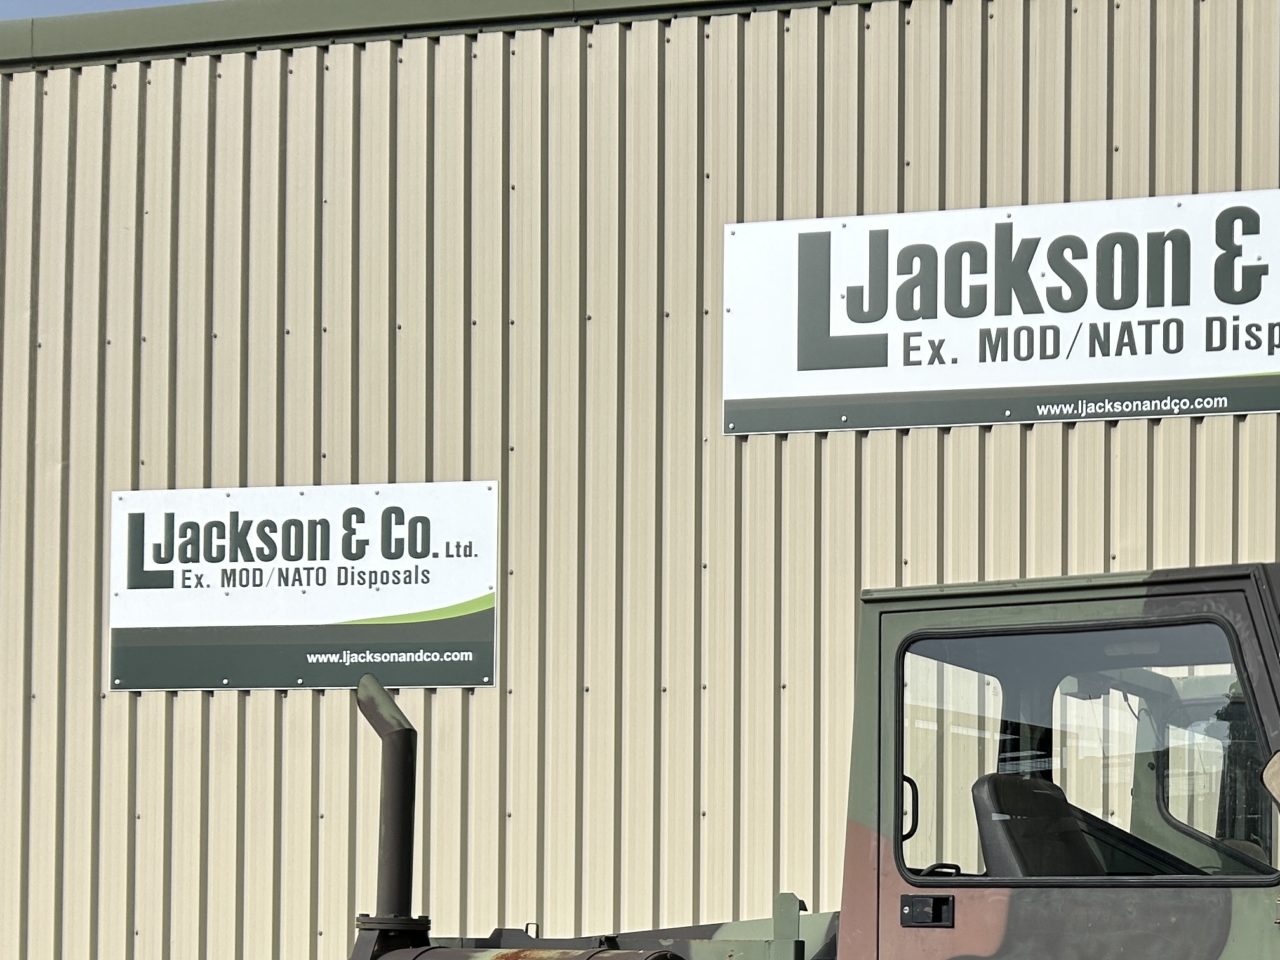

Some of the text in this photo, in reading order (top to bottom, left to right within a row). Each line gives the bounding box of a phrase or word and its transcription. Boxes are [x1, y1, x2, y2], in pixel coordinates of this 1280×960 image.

[1214, 206, 1268, 305] &
[903, 332, 957, 366] Ex.
[979, 318, 1183, 362] MOD/NATO
[1037, 397, 1227, 417] www.ljacksonandco.com
[342, 507, 369, 561] &
[381, 506, 438, 560] Co.
[446, 541, 477, 557] Ltd.
[182, 565, 431, 590] Ex. MOD/NATO Disposals
[307, 650, 472, 665] www.ljacksonandco.com
